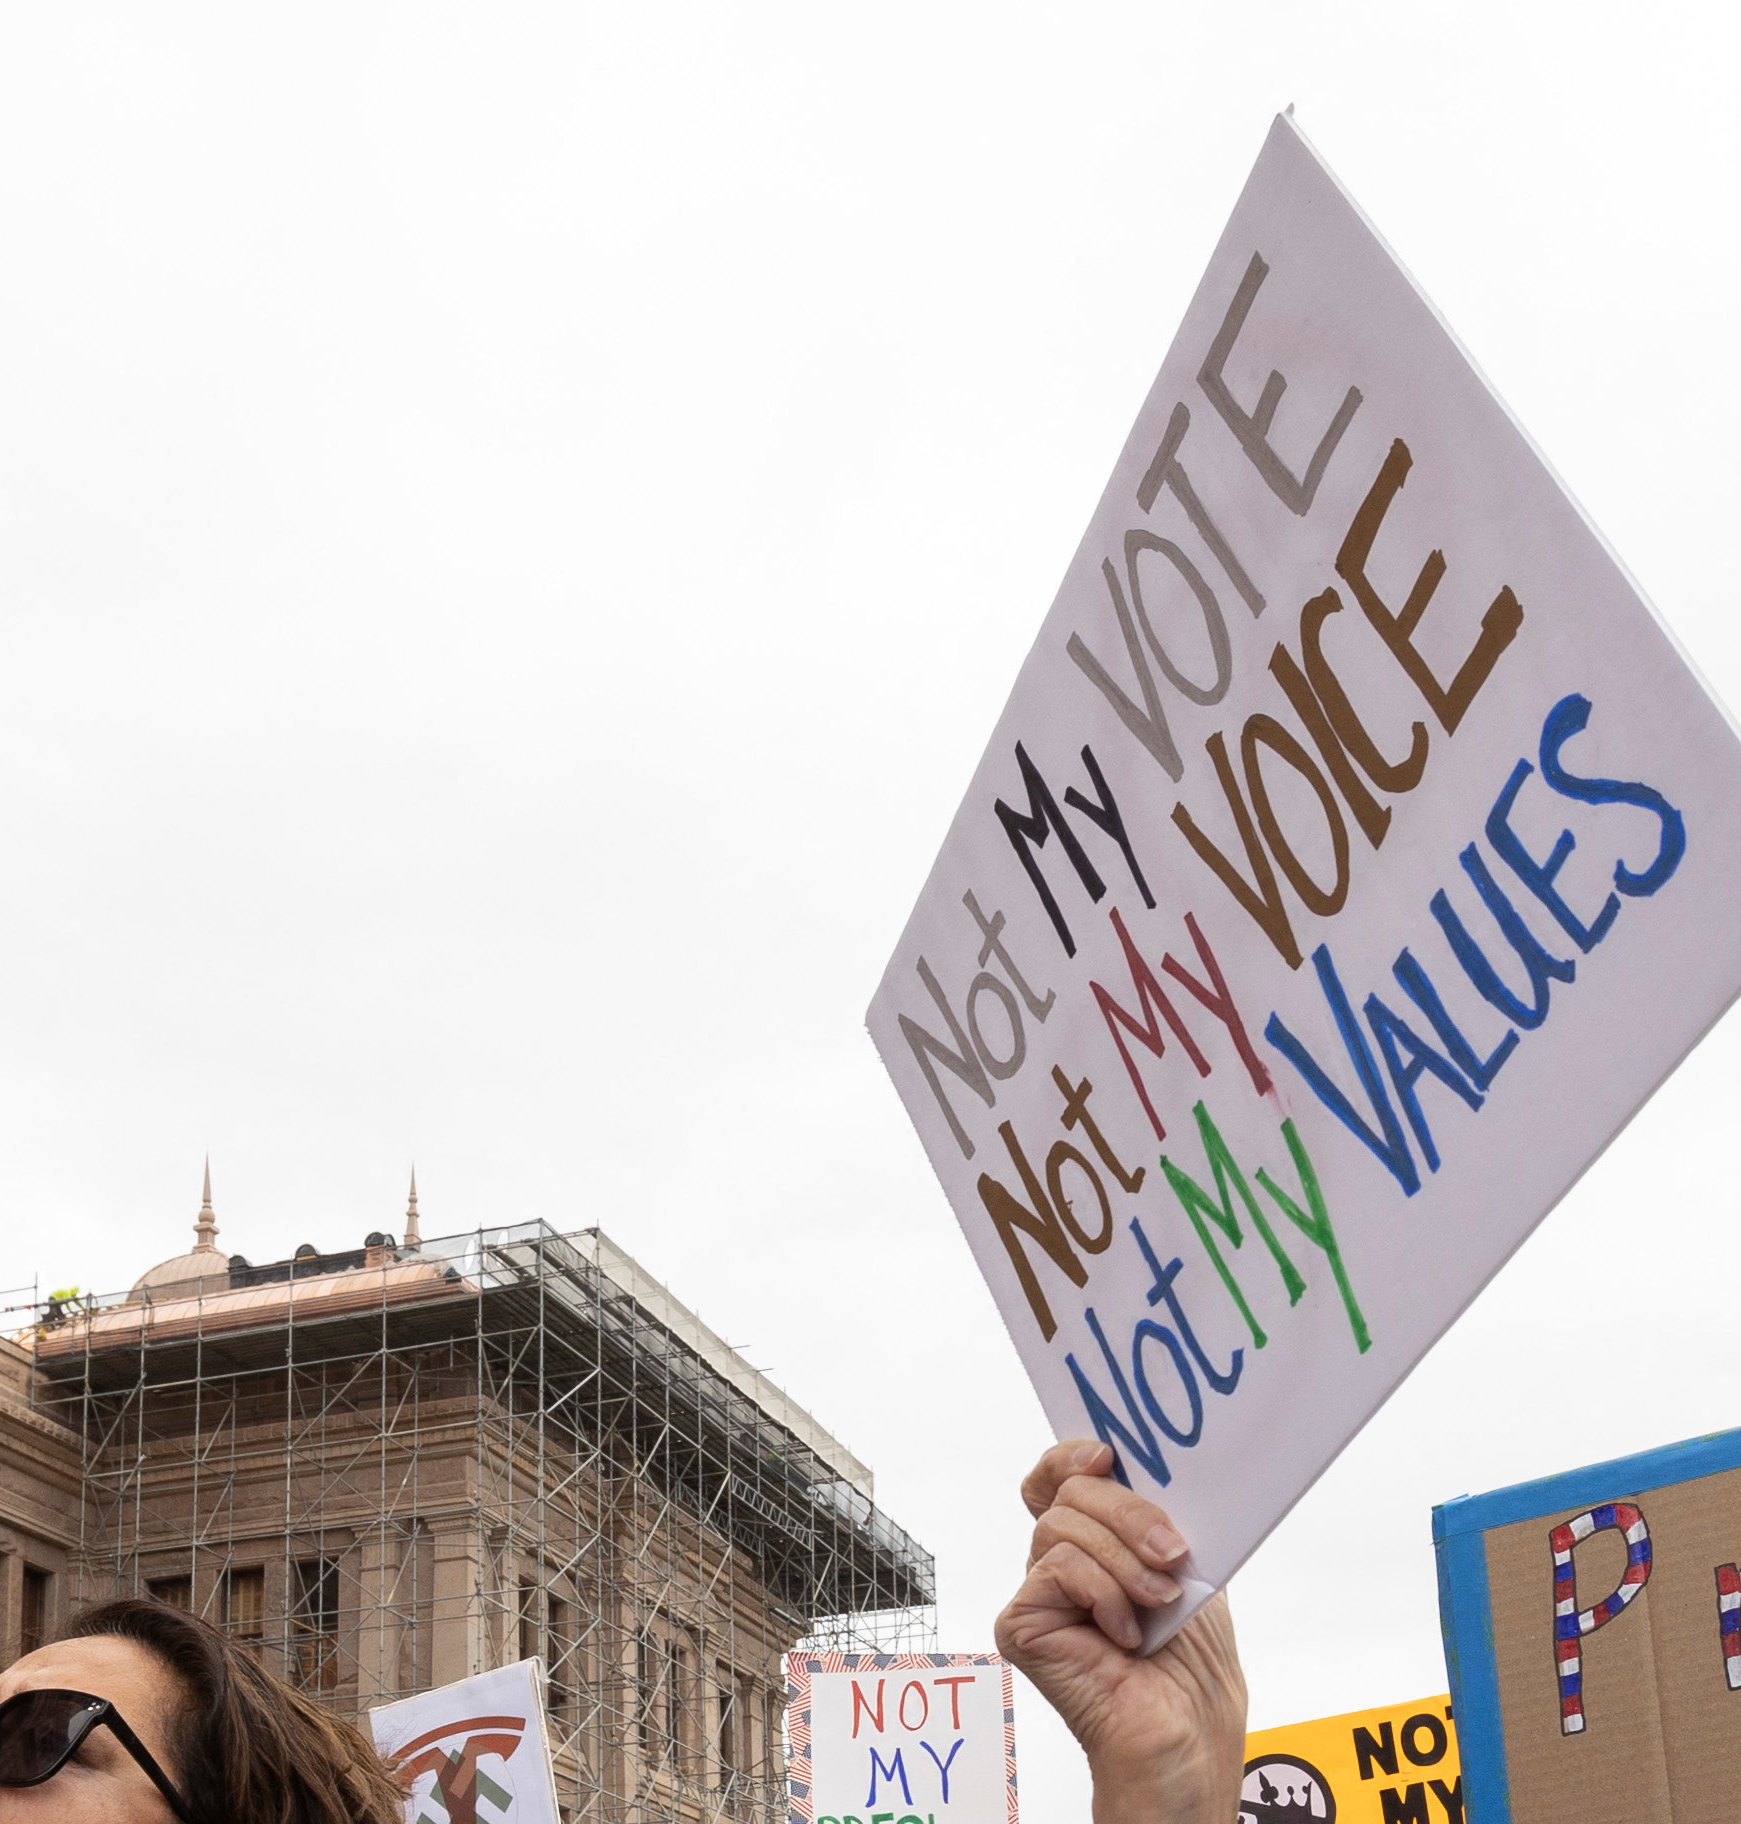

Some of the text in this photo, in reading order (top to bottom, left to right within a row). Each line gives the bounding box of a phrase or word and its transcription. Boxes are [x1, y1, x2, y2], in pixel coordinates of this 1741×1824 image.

[898, 888, 1056, 1159] Not
[1065, 251, 1362, 783] VOTE
[976, 1064, 1145, 1344] Not
[1171, 438, 1523, 968] VOICE
[1064, 1218, 1244, 1487] Not
[1265, 693, 1687, 1197] VALUES
[851, 1676, 976, 1739] NOT
[866, 1738, 965, 1808] MY
[1353, 1705, 1454, 1780] NO
